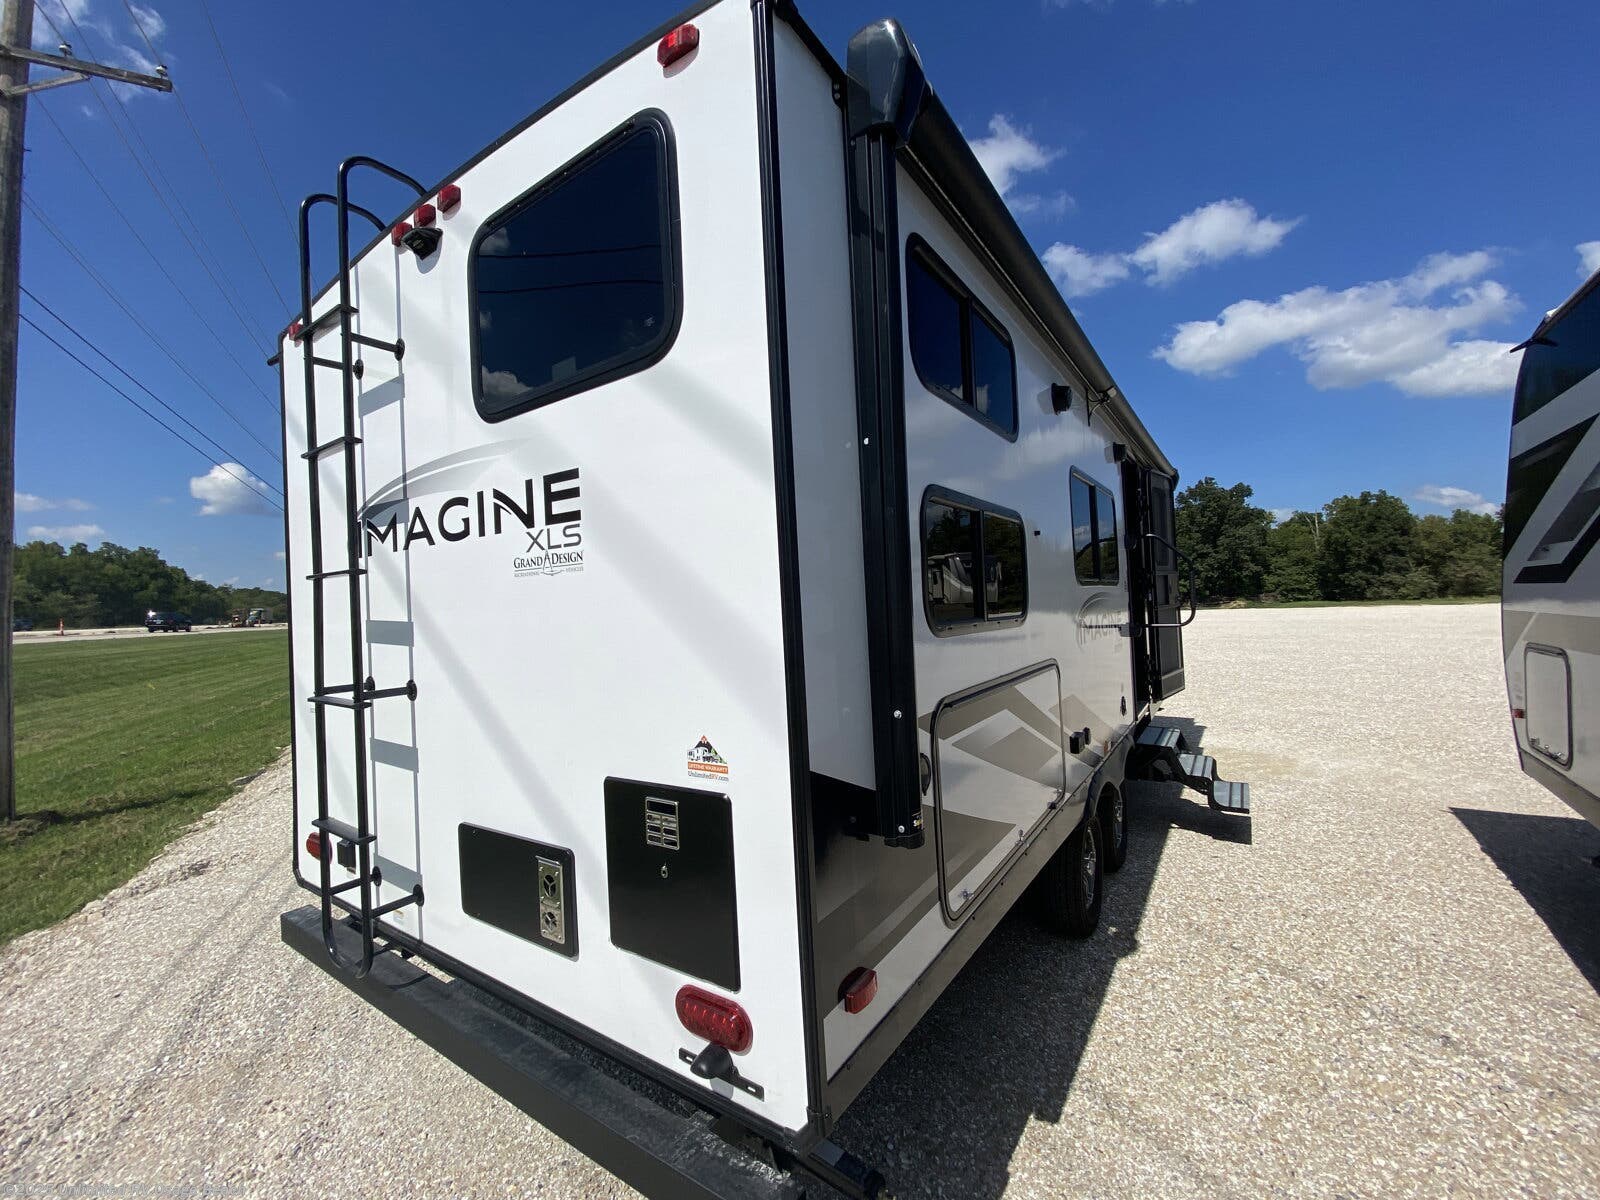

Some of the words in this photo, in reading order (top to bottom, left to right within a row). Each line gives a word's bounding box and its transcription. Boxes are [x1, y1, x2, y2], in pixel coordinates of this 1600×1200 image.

[525, 523, 582, 553] XLS
[513, 556, 543, 569] GRAND
[551, 551, 584, 565] DESIGN
